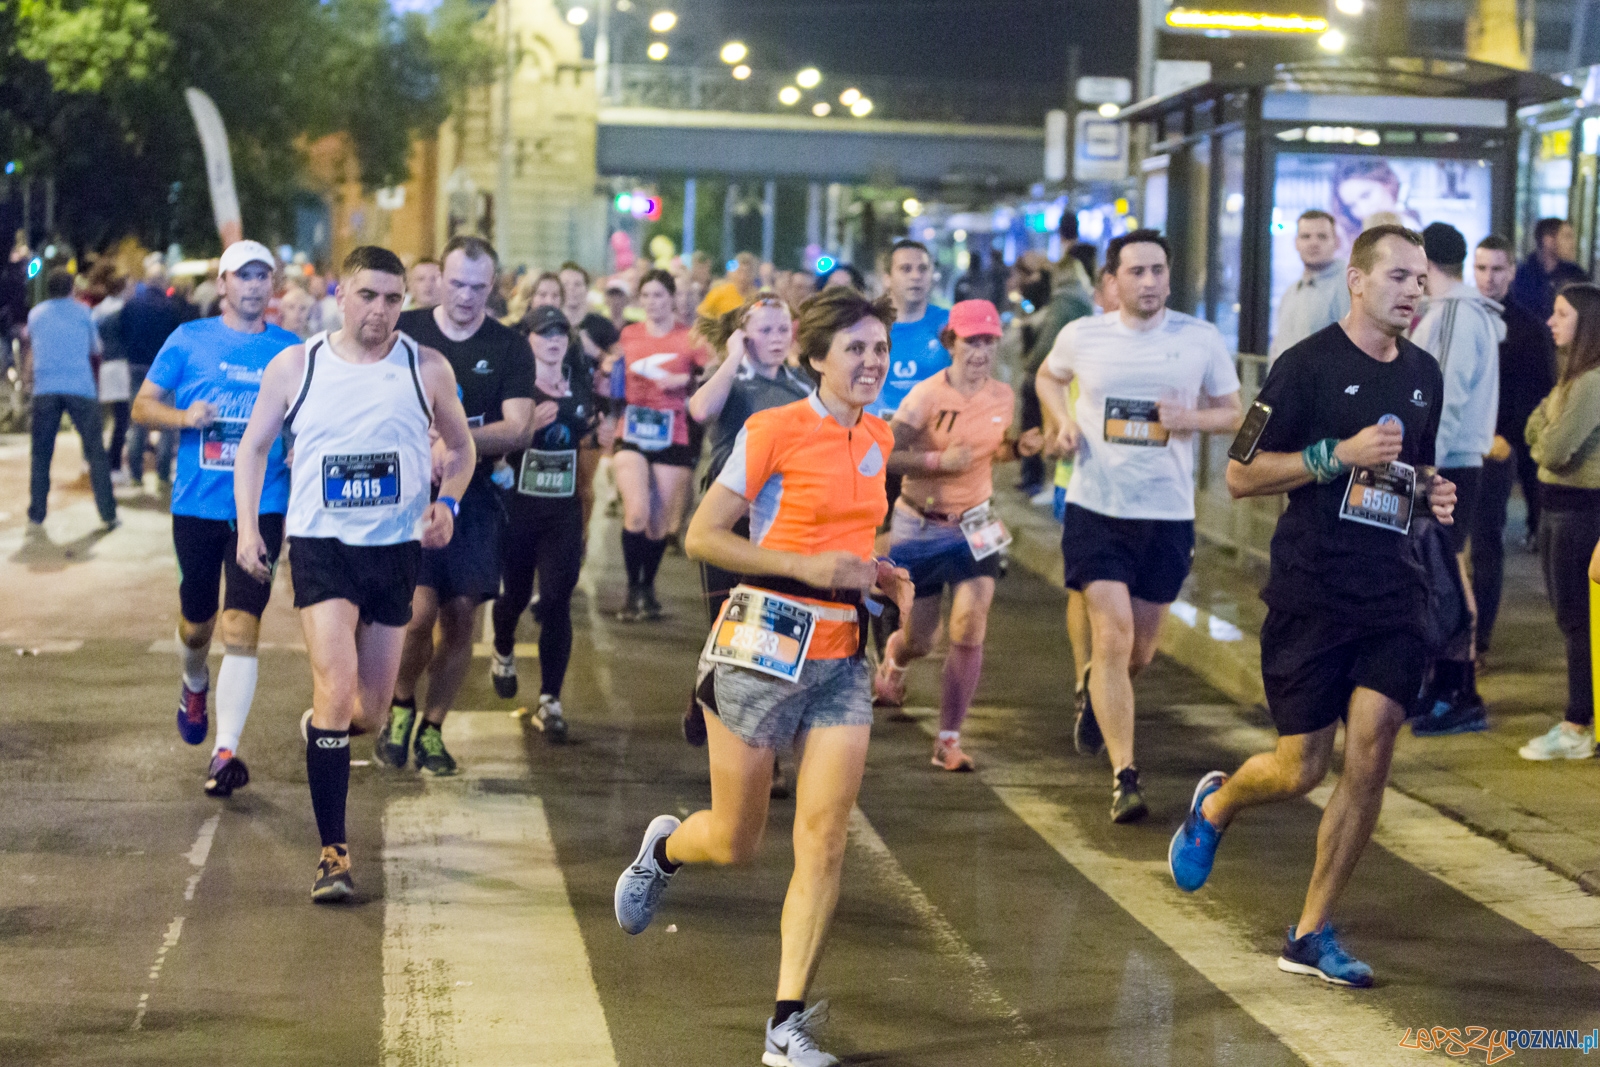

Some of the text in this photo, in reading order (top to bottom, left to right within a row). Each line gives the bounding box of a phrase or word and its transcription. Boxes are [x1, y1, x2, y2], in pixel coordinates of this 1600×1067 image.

[220, 442, 239, 460] 29
[341, 479, 382, 499] 4615
[1361, 487, 1399, 516] 5590
[730, 623, 780, 656] 2523
